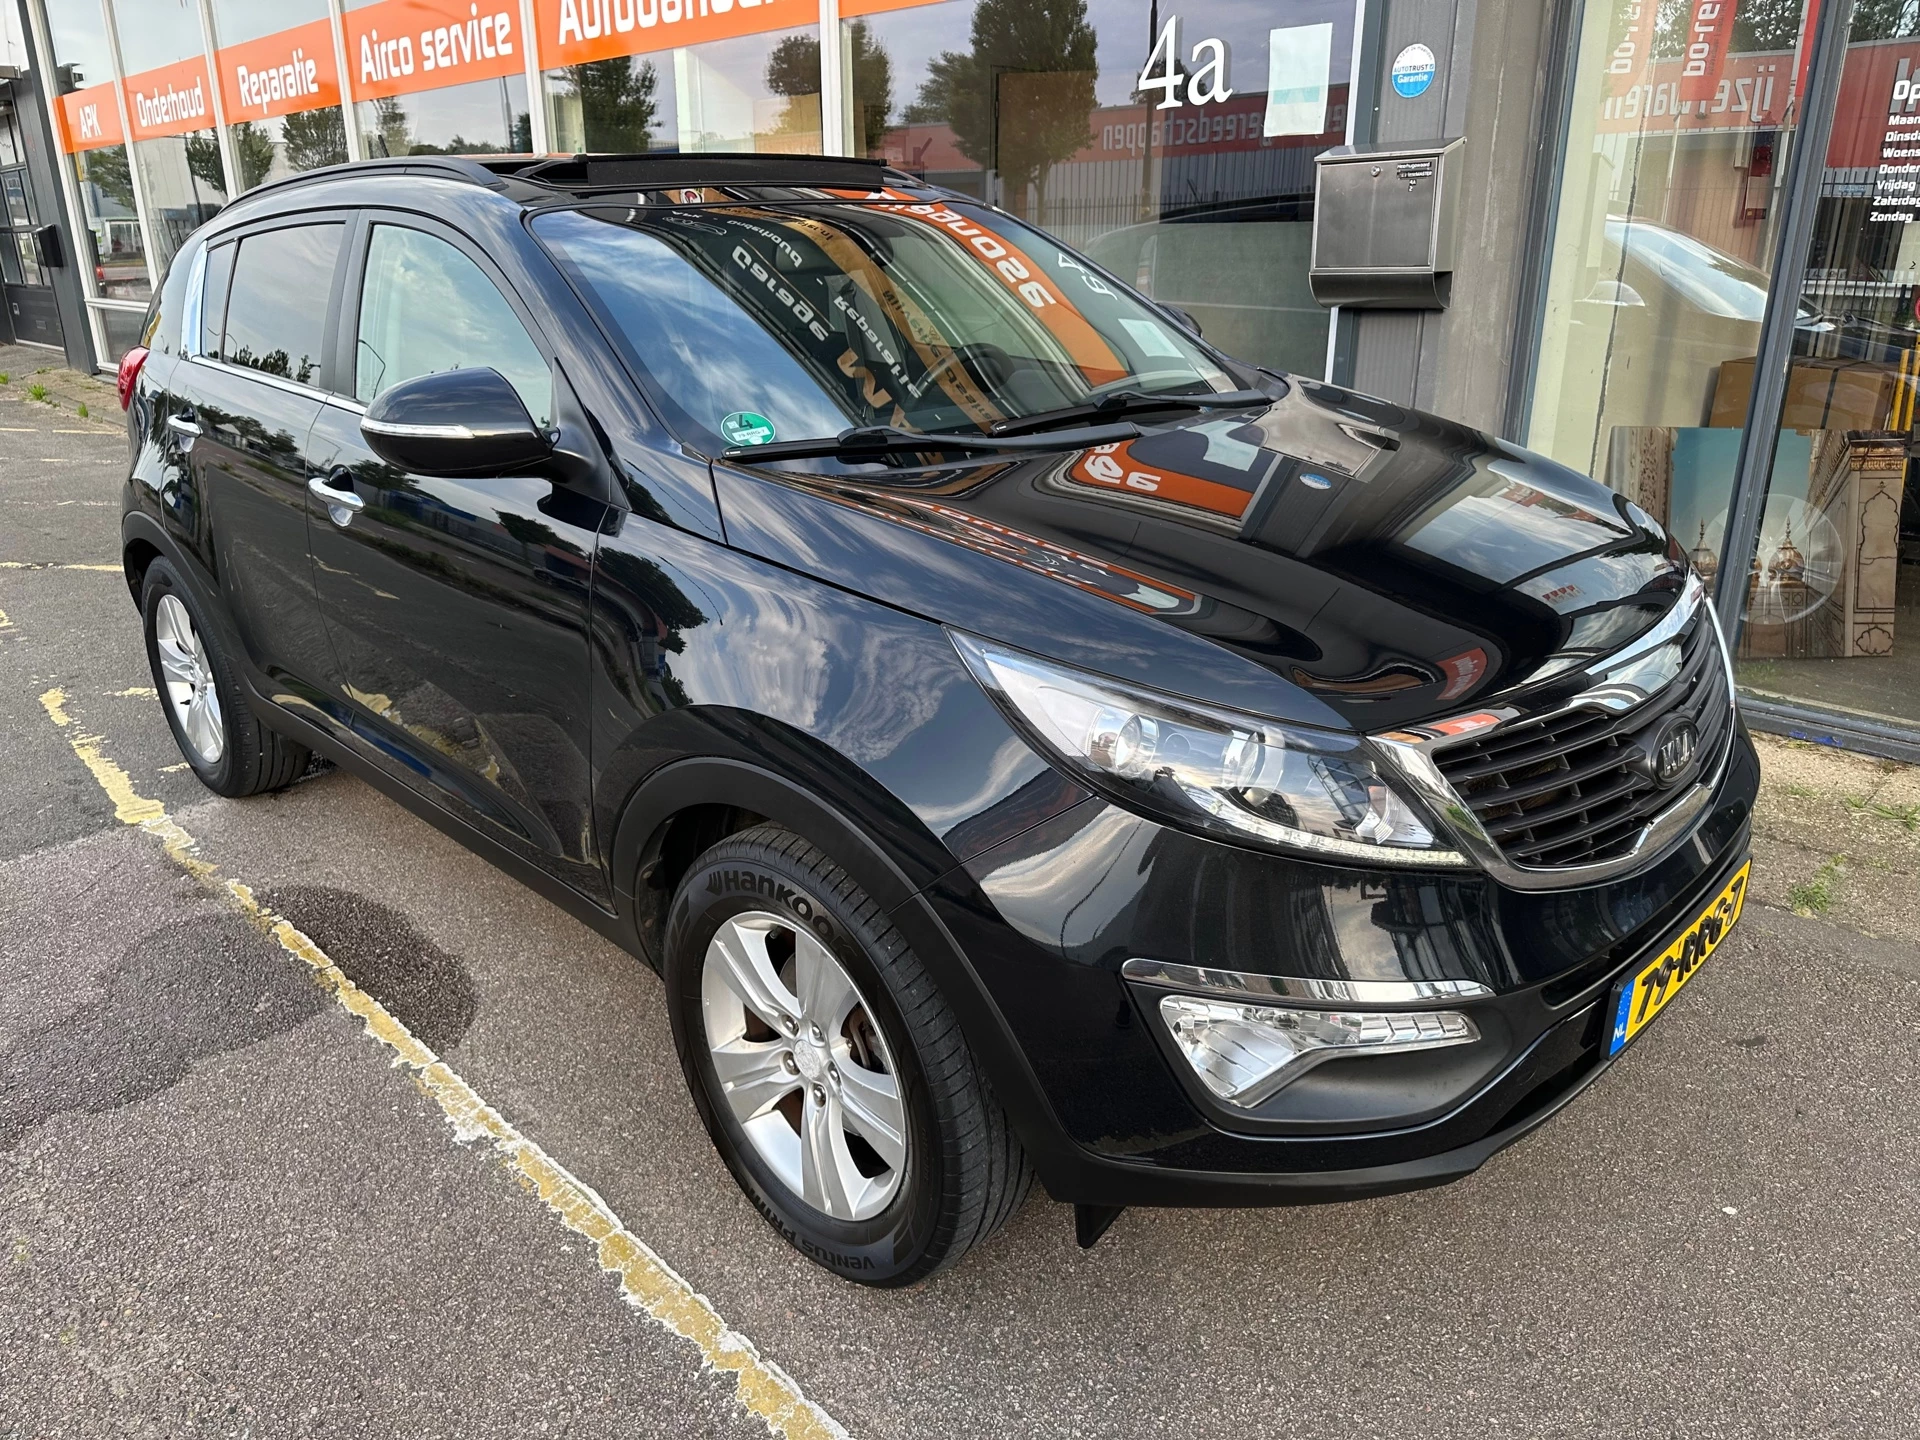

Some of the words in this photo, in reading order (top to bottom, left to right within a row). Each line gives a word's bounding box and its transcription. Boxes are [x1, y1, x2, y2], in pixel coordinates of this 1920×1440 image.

[361, 29, 415, 84] Airco
[420, 3, 513, 72] service
[1682, 0, 1721, 76] bo-re
[237, 48, 319, 114] Reparatie
[1139, 14, 1233, 110] 4a
[1397, 73, 1429, 84] Garantie
[79, 103, 102, 139] APK
[136, 76, 205, 127] Onderhoud
[1873, 195, 1920, 207] Zaterdag
[1876, 179, 1916, 191] Vrijdag
[1870, 212, 1913, 223] Zondag
[1661, 729, 1695, 776] KIA
[1612, 1024, 1625, 1042] NL
